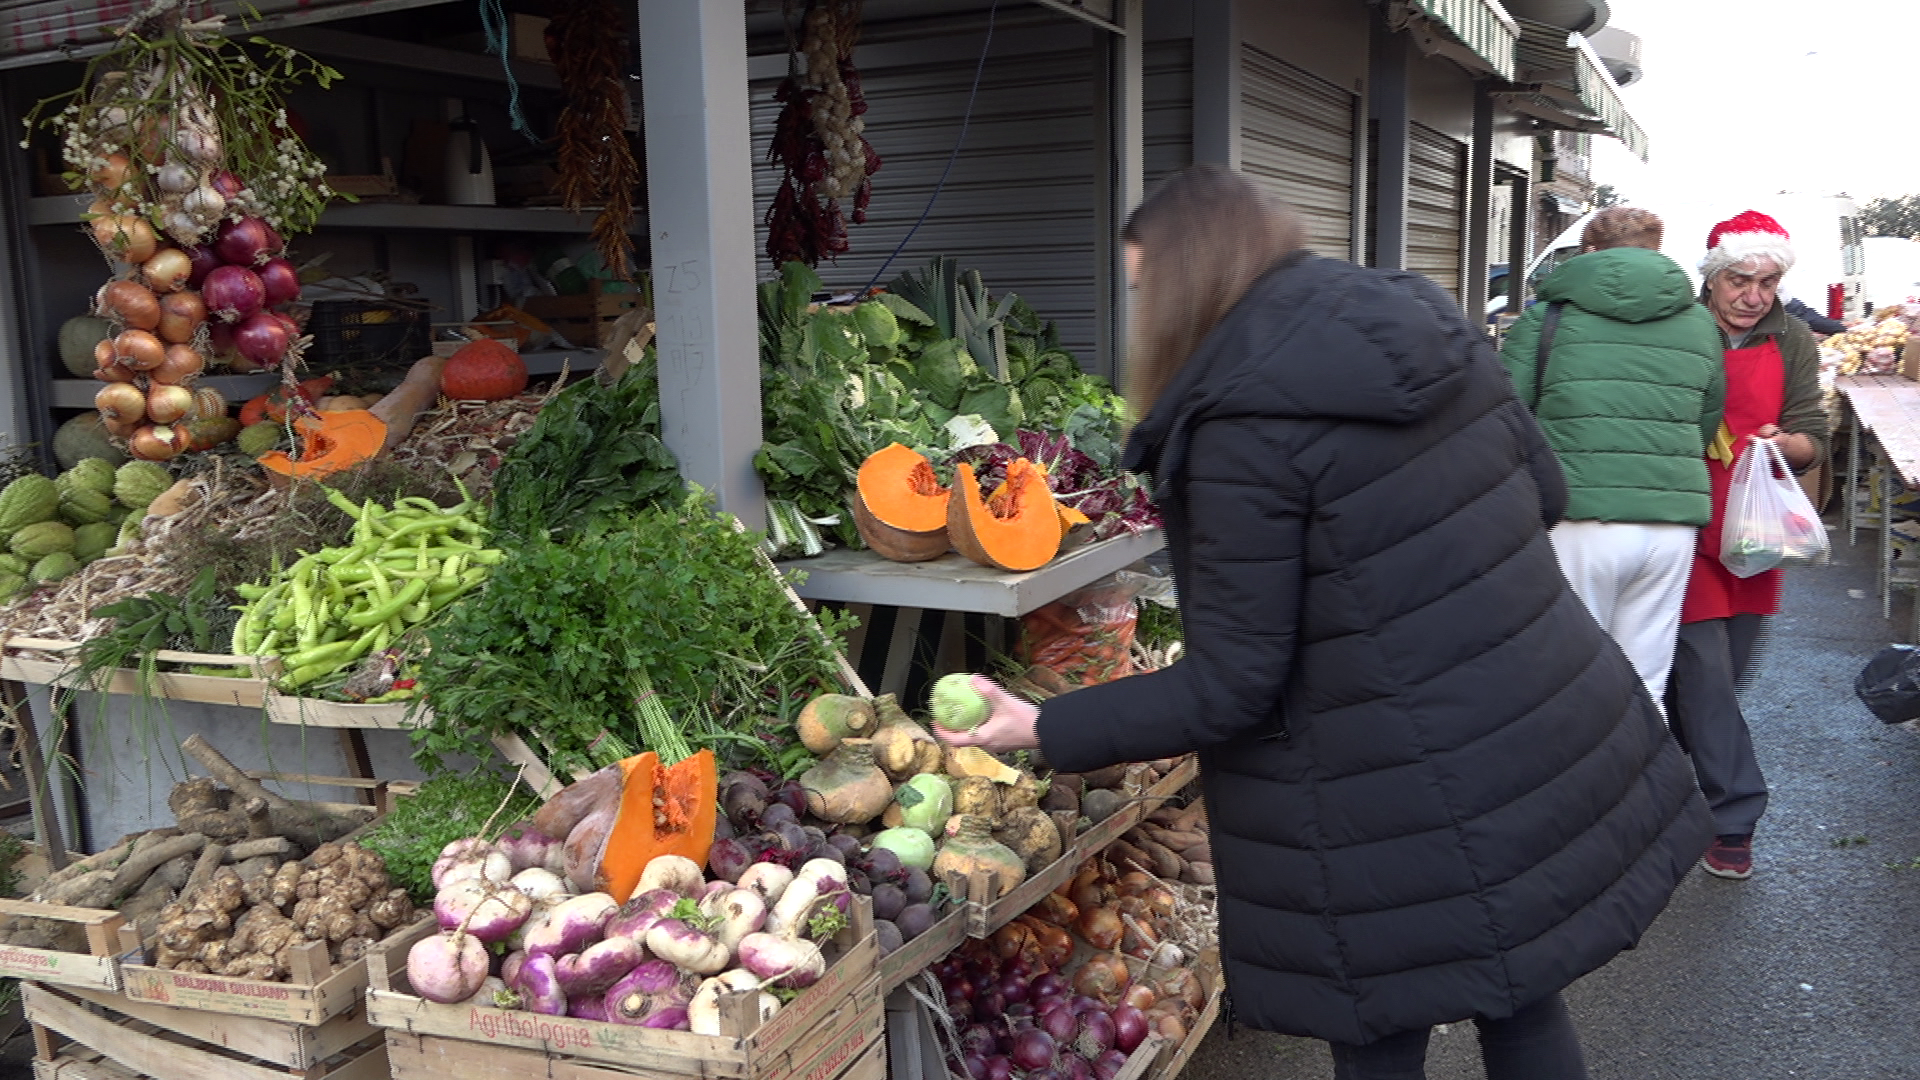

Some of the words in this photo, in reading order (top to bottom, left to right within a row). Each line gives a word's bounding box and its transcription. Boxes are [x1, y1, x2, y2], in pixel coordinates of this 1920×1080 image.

[0, 947, 49, 970] gribologna
[172, 975, 228, 994] BALBONI
[229, 982, 290, 1000] GIULIANO
[470, 1007, 592, 1049] Agribologna
